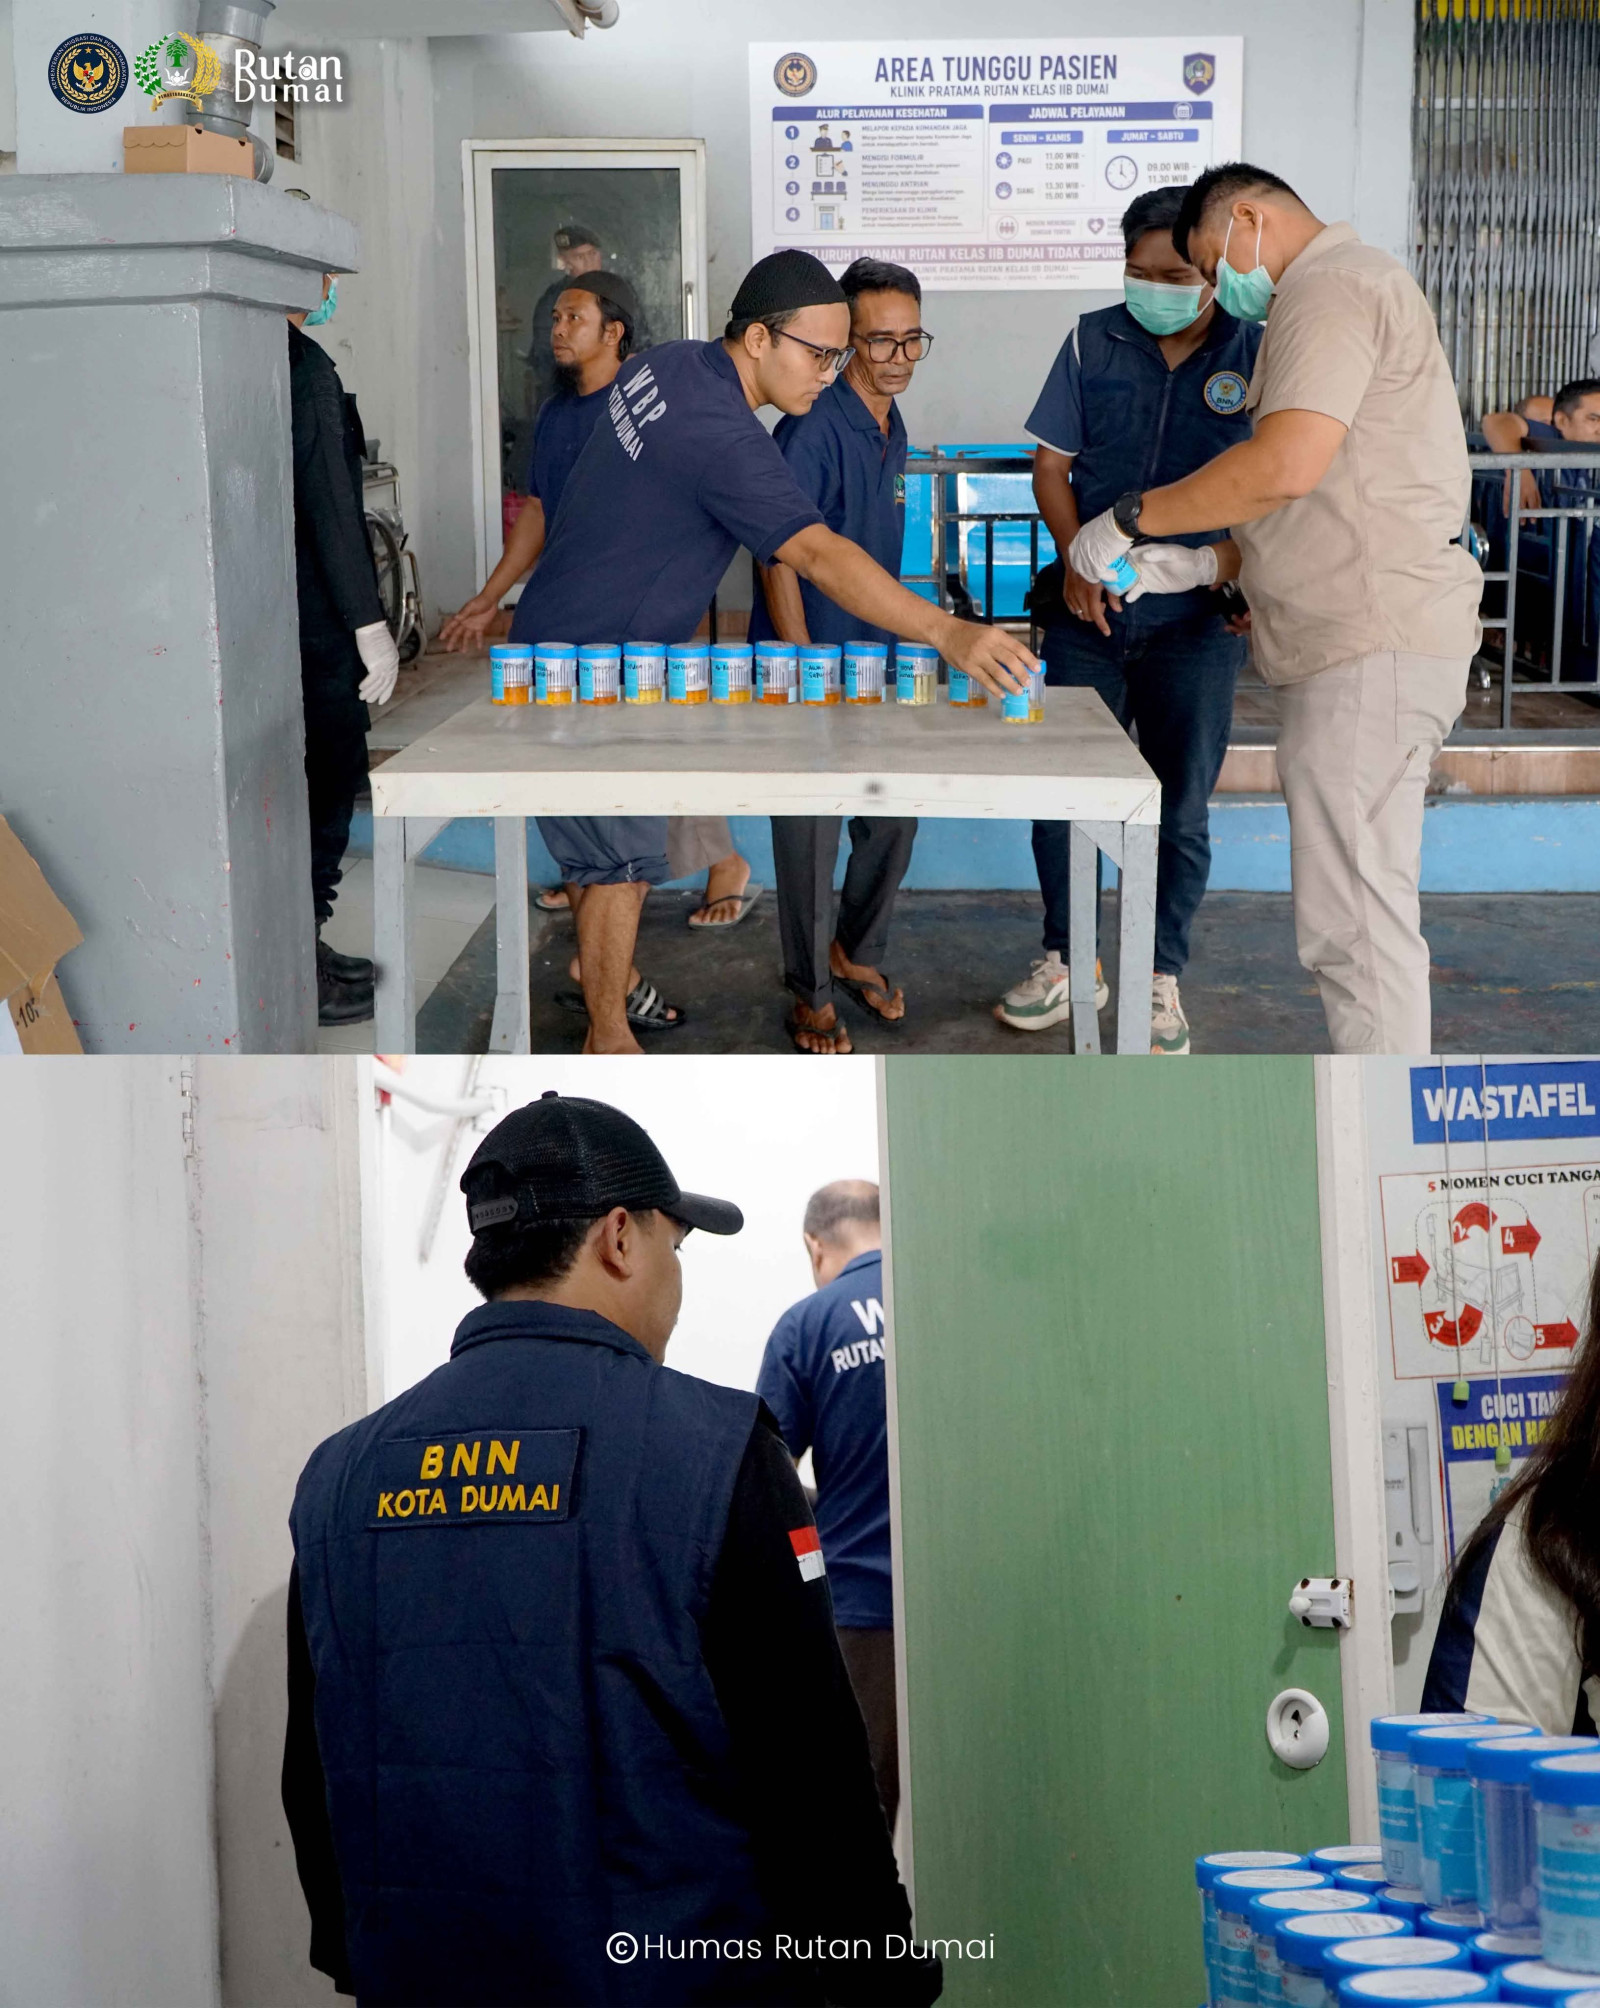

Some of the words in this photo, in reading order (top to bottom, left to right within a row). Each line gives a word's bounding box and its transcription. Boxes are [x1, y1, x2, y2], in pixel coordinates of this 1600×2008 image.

[875, 57, 934, 82] AREA
[943, 56, 1031, 82] TUNGGU
[1040, 54, 1117, 80] PASIEN
[890, 86, 926, 98] KLINIK
[929, 86, 980, 98] PRATAMA
[984, 85, 1019, 96] RUTAN
[1023, 84, 1056, 96] KELAS
[1060, 84, 1072, 96] IIB
[1076, 84, 1108, 95] DUMAI
[816, 108, 840, 119] ALUR
[842, 108, 894, 118] PELAYANAN
[896, 108, 948, 118] KESEHATAN
[1029, 108, 1068, 119] JADWAL
[1070, 106, 1126, 118] PELAYANAN
[1013, 134, 1037, 142] SENIN
[1046, 133, 1071, 142] KAMIS
[1121, 132, 1148, 142] JUMAT
[1157, 132, 1184, 140] SABTU
[1066, 162, 1079, 170] WIB
[1174, 162, 1190, 171] WIB
[1172, 174, 1188, 183] WIB
[808, 249, 851, 262] ELURUH
[855, 249, 906, 261] LAYANAN
[909, 249, 946, 260] RUTAN
[950, 248, 985, 260] KELAS
[989, 248, 1004, 260] IIB
[1007, 247, 1044, 260] DUMAI
[1047, 246, 1080, 259] TIDAK
[1084, 246, 1126, 259] DIPUNG
[615, 414, 644, 462] DUMAI
[1422, 1082, 1596, 1122] WASTAFEL
[1428, 1182, 1436, 1192] 5
[1440, 1176, 1500, 1190] MOMEN
[1504, 1173, 1544, 1186] CUCI
[1547, 1169, 1600, 1184] TANGA
[1452, 1221, 1466, 1240] 2
[1504, 1228, 1515, 1248] 4
[1393, 1262, 1400, 1280] 1
[1430, 1315, 1444, 1334] 3
[1536, 1328, 1546, 1346] 5
[1481, 1392, 1526, 1420] CUCI
[1528, 1390, 1561, 1416] TAN
[1452, 1421, 1523, 1450] DENGAN
[377, 1488, 448, 1518] KOTA
[460, 1484, 560, 1513] DUMAI
